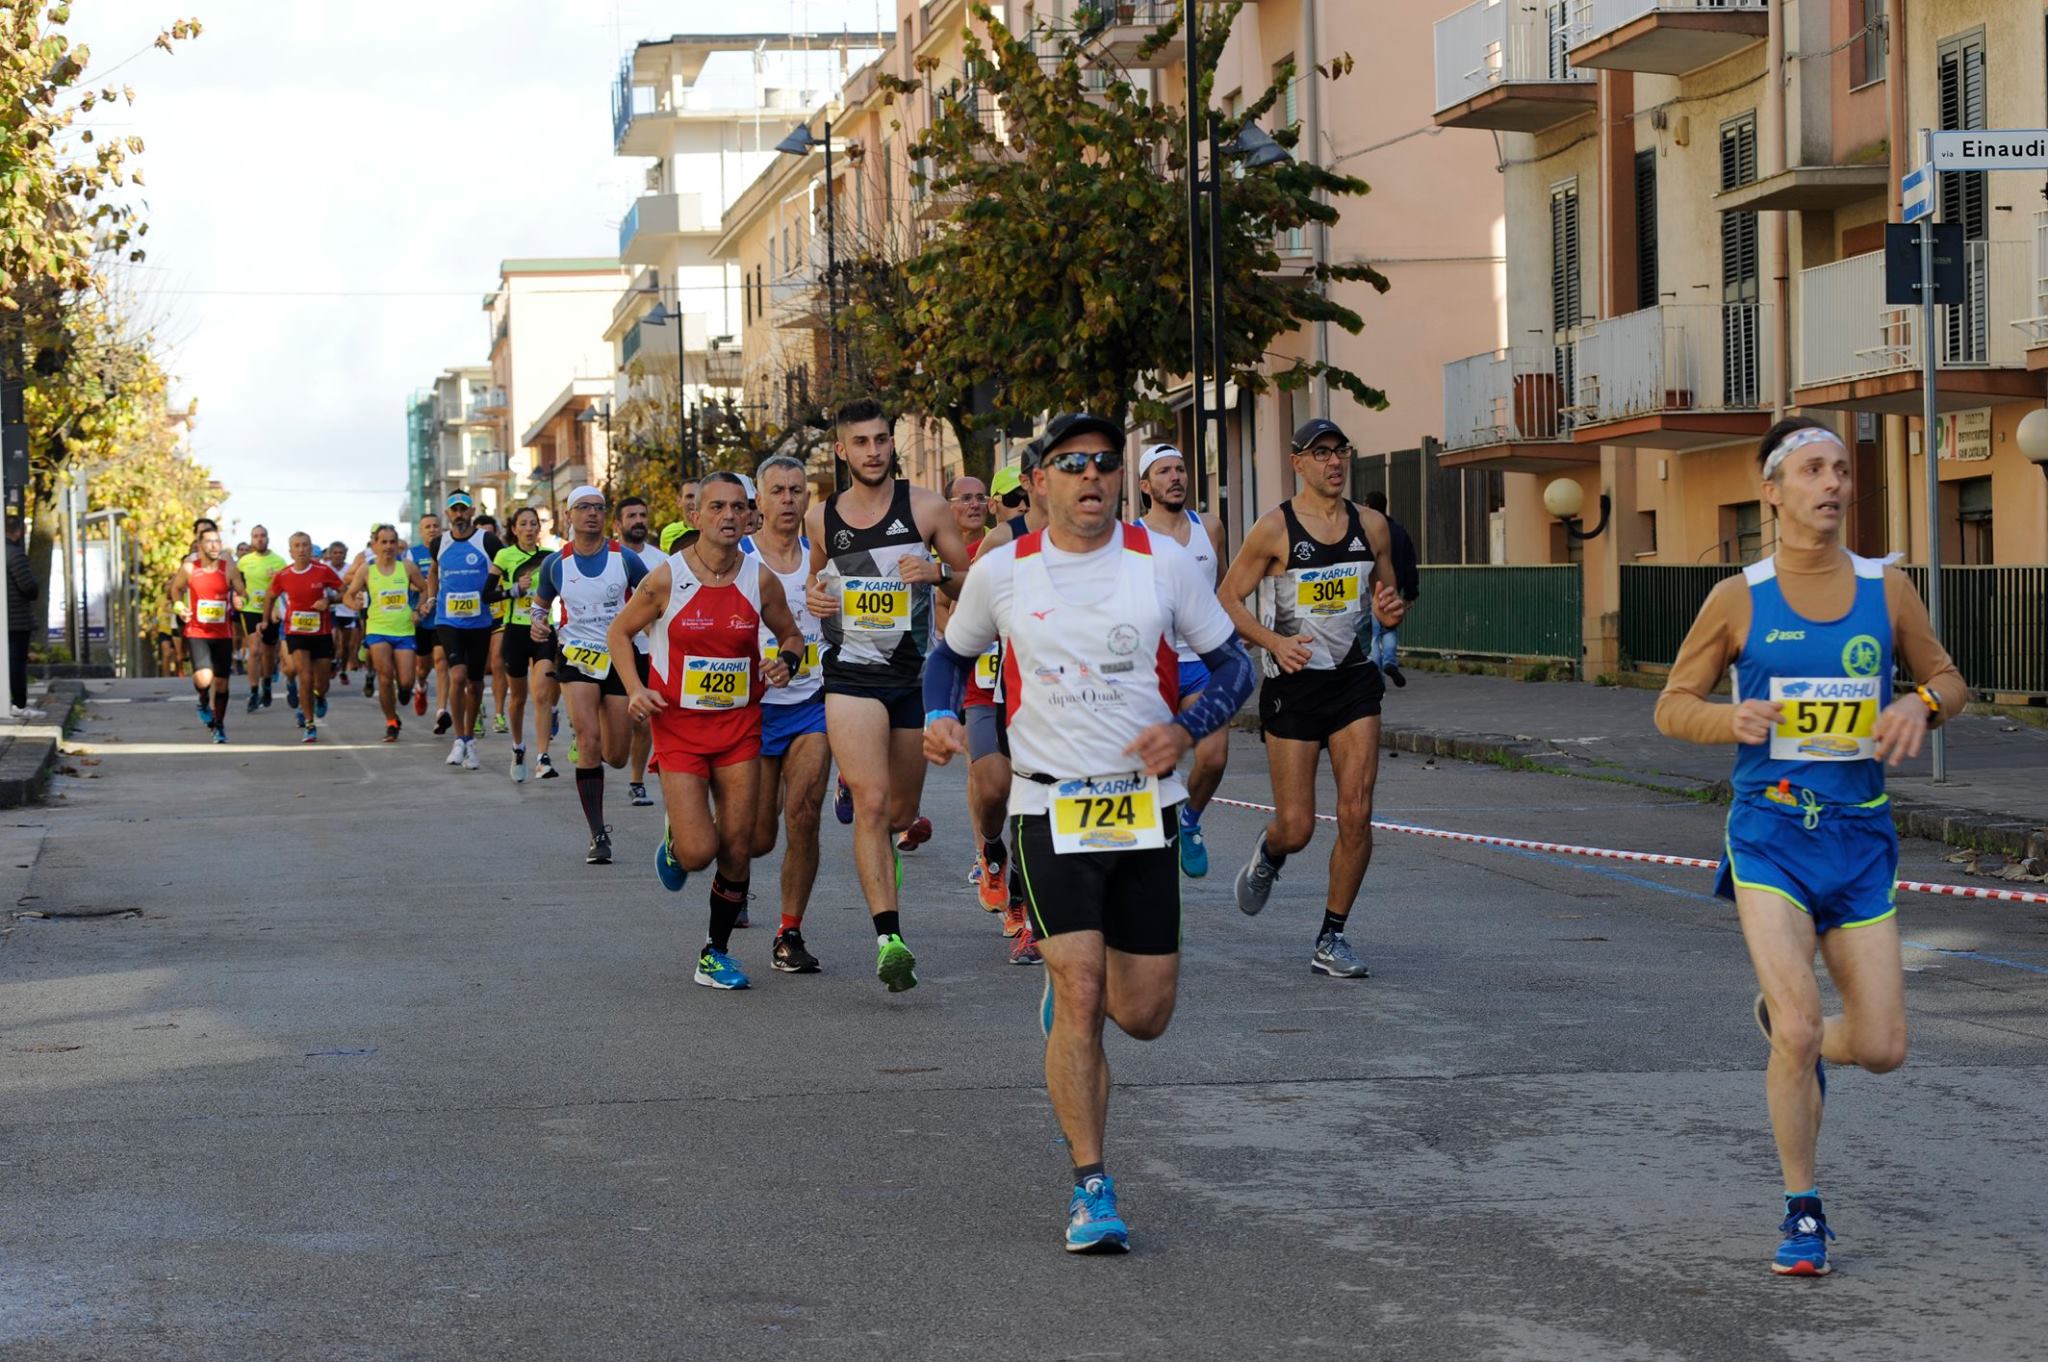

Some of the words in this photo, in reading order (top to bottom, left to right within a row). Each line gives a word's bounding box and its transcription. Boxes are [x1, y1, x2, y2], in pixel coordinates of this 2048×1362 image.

[1962, 140, 2045, 158] Einaudi
[886, 527, 909, 536] adidas
[1321, 567, 1357, 580] KARHU
[864, 581, 906, 592] KARHU
[1313, 579, 1345, 601] 304
[454, 600, 473, 610] 720
[856, 593, 894, 613] 409
[1778, 630, 1806, 640] asics
[574, 647, 600, 666] 727
[709, 661, 747, 672] KARHU
[700, 673, 735, 693] 428
[1814, 683, 1875, 697] KARHU
[1797, 701, 1861, 734] 577
[1089, 777, 1147, 795] KARHU
[1074, 795, 1136, 828] 724
